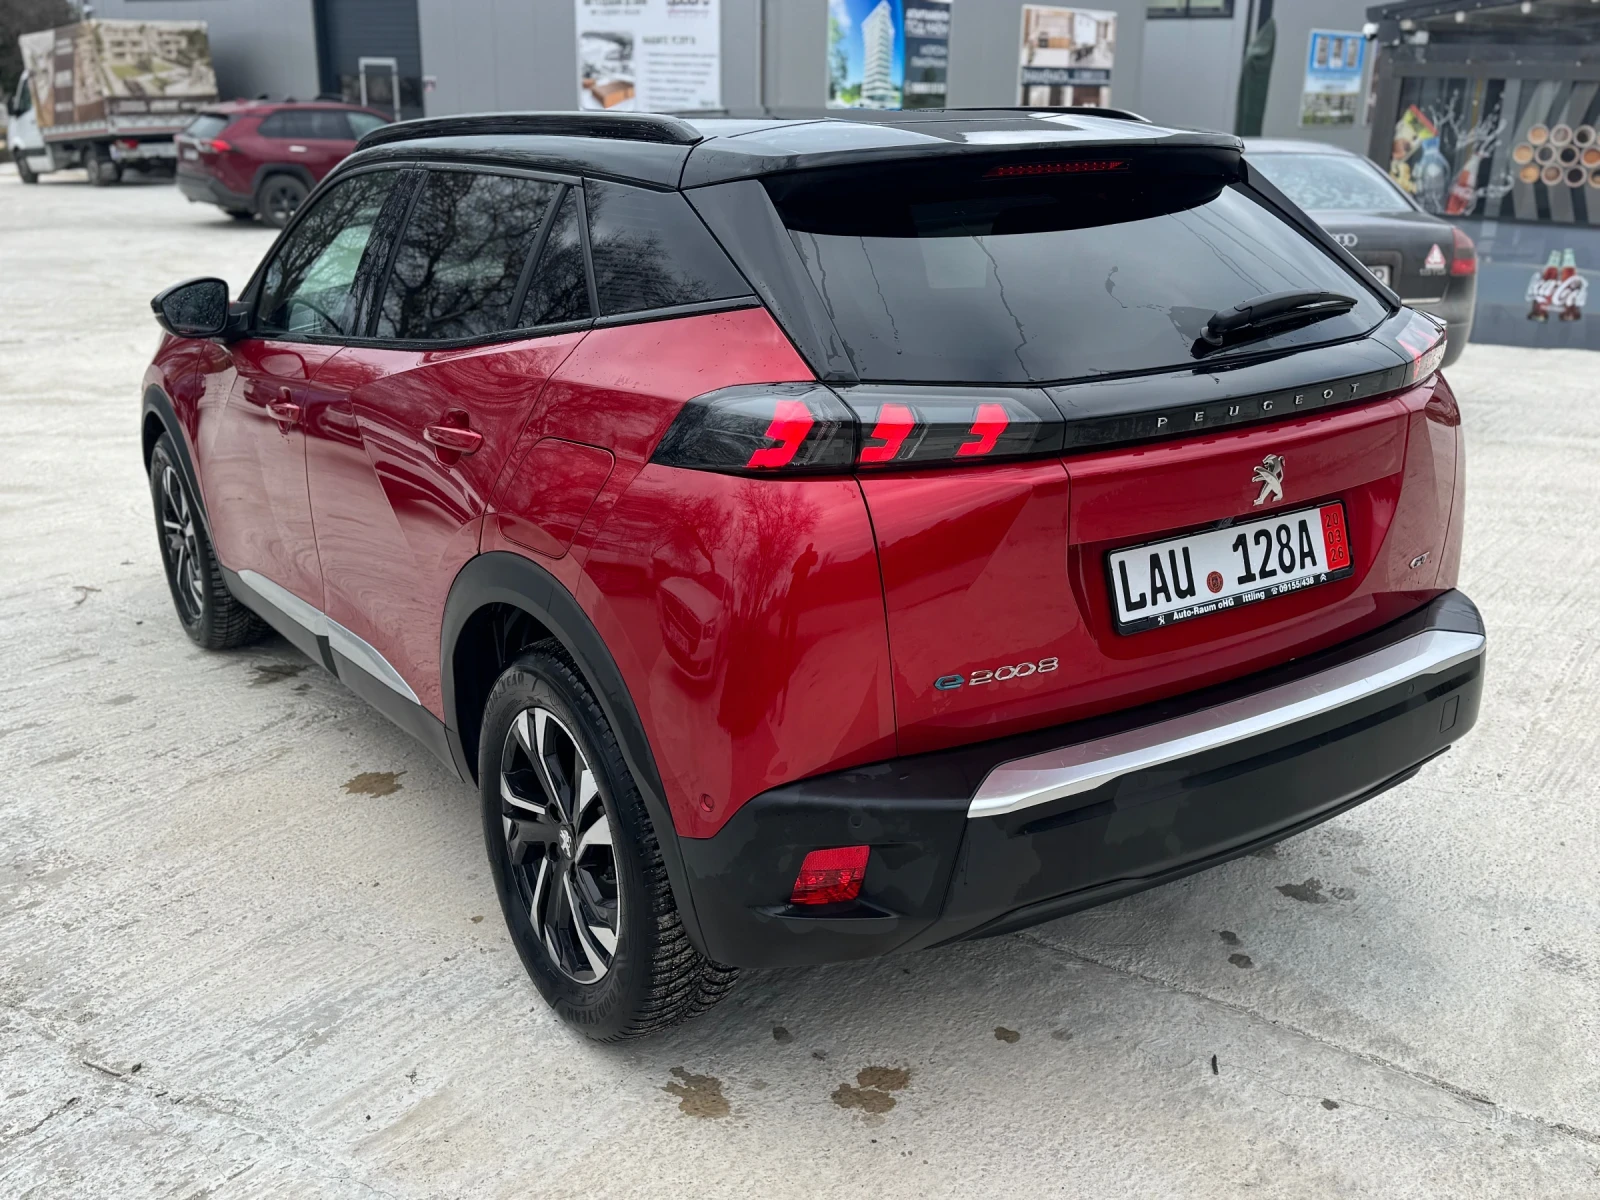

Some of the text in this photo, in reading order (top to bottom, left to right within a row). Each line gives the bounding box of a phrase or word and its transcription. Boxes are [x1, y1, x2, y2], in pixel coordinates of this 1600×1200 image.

[1157, 383, 1360, 428] PEUGEOT
[1325, 512, 1339, 528] 20
[1328, 529, 1342, 545] 03
[1118, 519, 1318, 612] LAU 128A
[1331, 545, 1344, 563] 26
[1173, 576, 1315, 621] Auto-Raum oHG Ittling 09155/438
